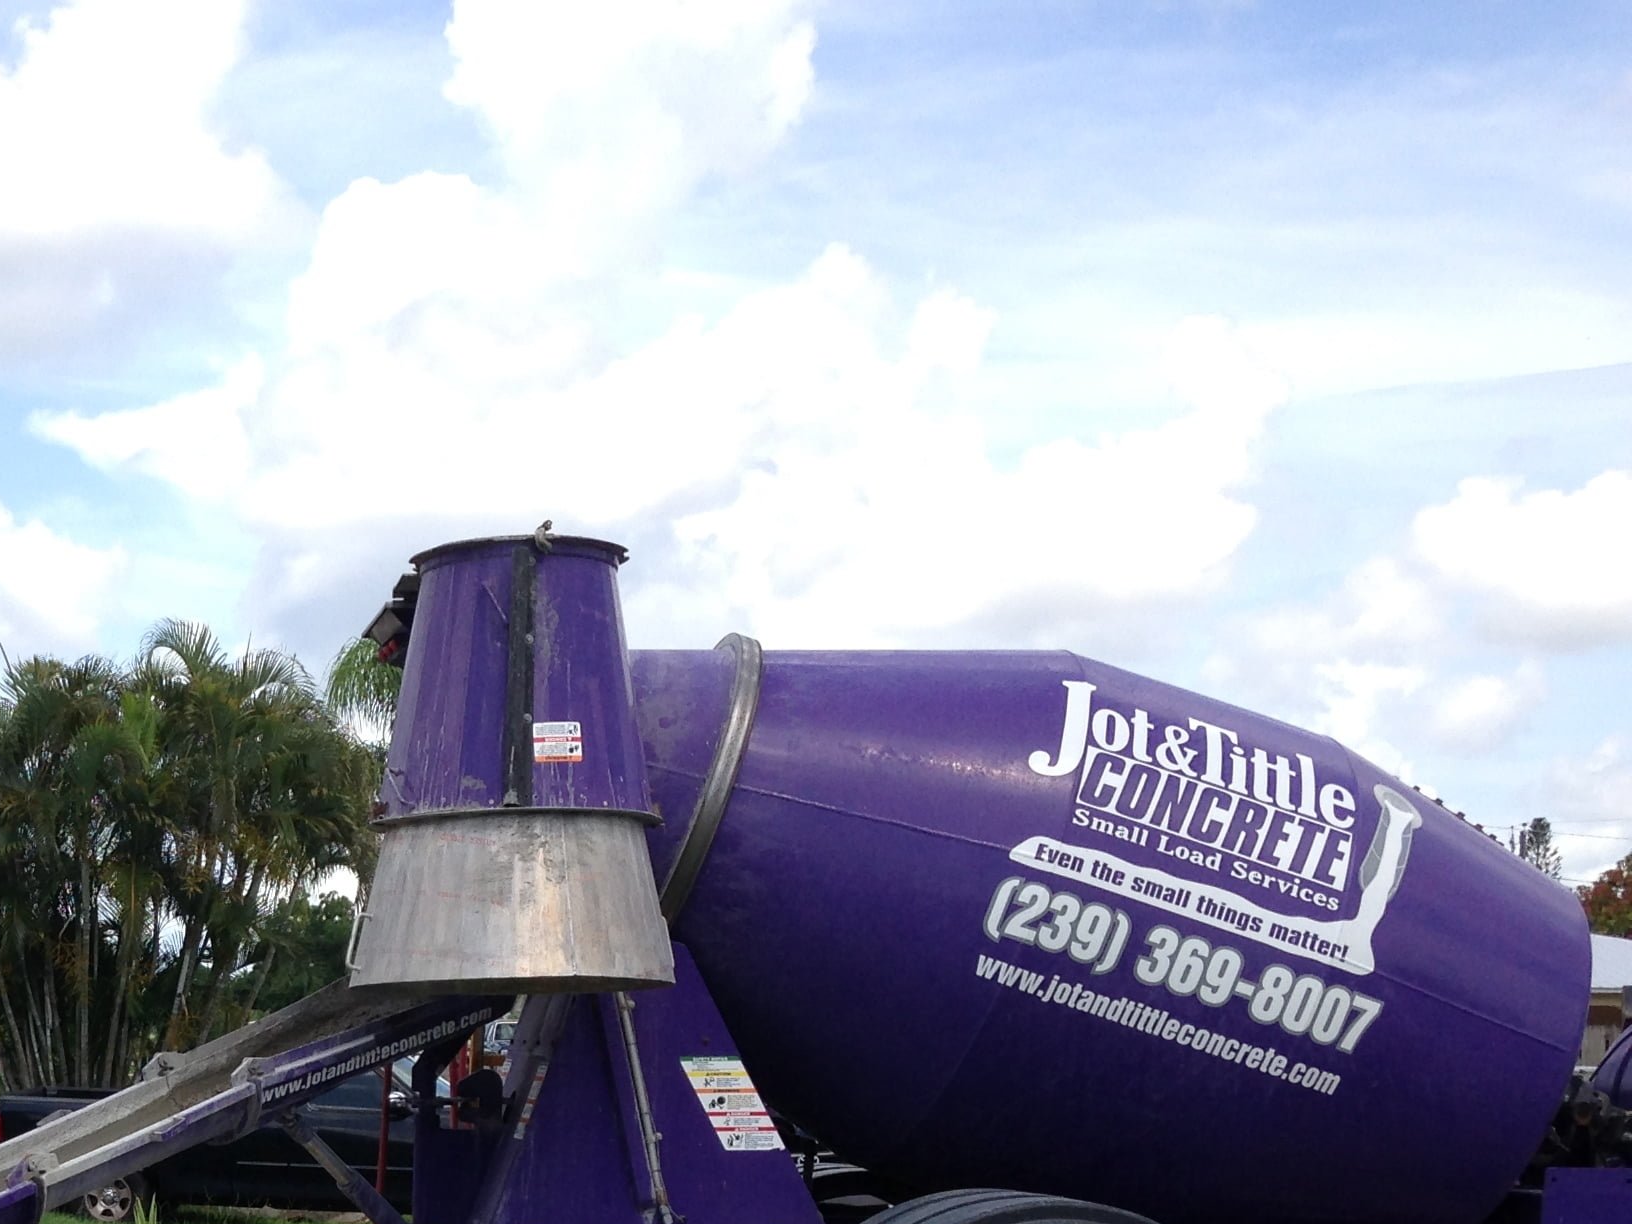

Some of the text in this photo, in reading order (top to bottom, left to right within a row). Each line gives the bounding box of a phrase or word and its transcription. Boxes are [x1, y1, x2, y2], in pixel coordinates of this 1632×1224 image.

[1072, 808, 1340, 911] Small Load Services
[1079, 752, 1351, 886] CONCRETE
[983, 876, 1384, 1054] (239) 369-8007
[1034, 843, 1350, 963] Even the small things matter!
[975, 954, 1342, 1096] www.jotandtittleconcrete.com
